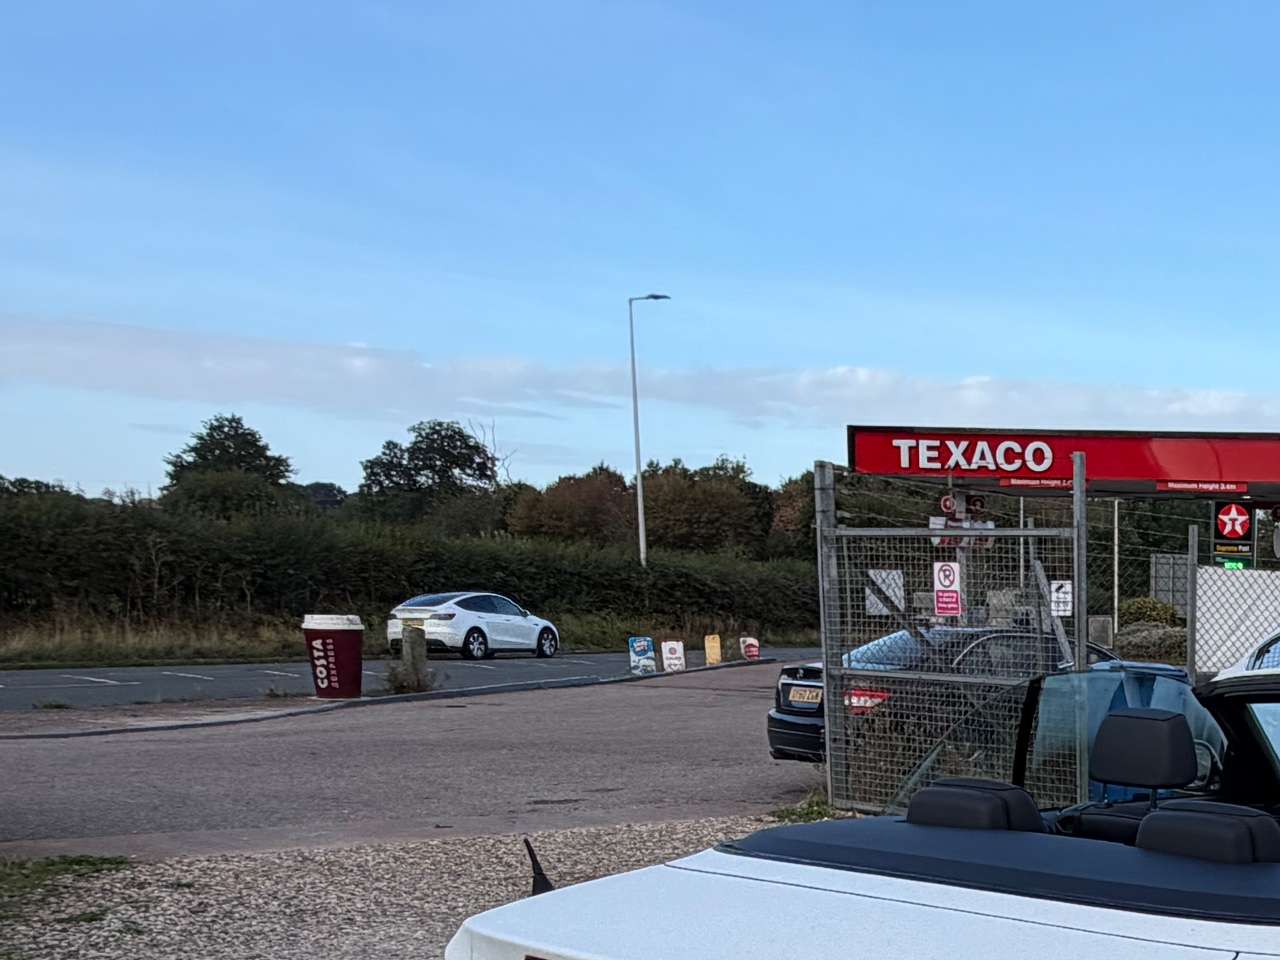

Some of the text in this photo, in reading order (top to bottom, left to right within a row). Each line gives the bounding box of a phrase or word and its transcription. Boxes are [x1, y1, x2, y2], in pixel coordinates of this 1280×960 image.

[892, 439, 1053, 472] TEXACO
[1199, 483, 1219, 491] Height
[312, 639, 328, 689] COSTA
